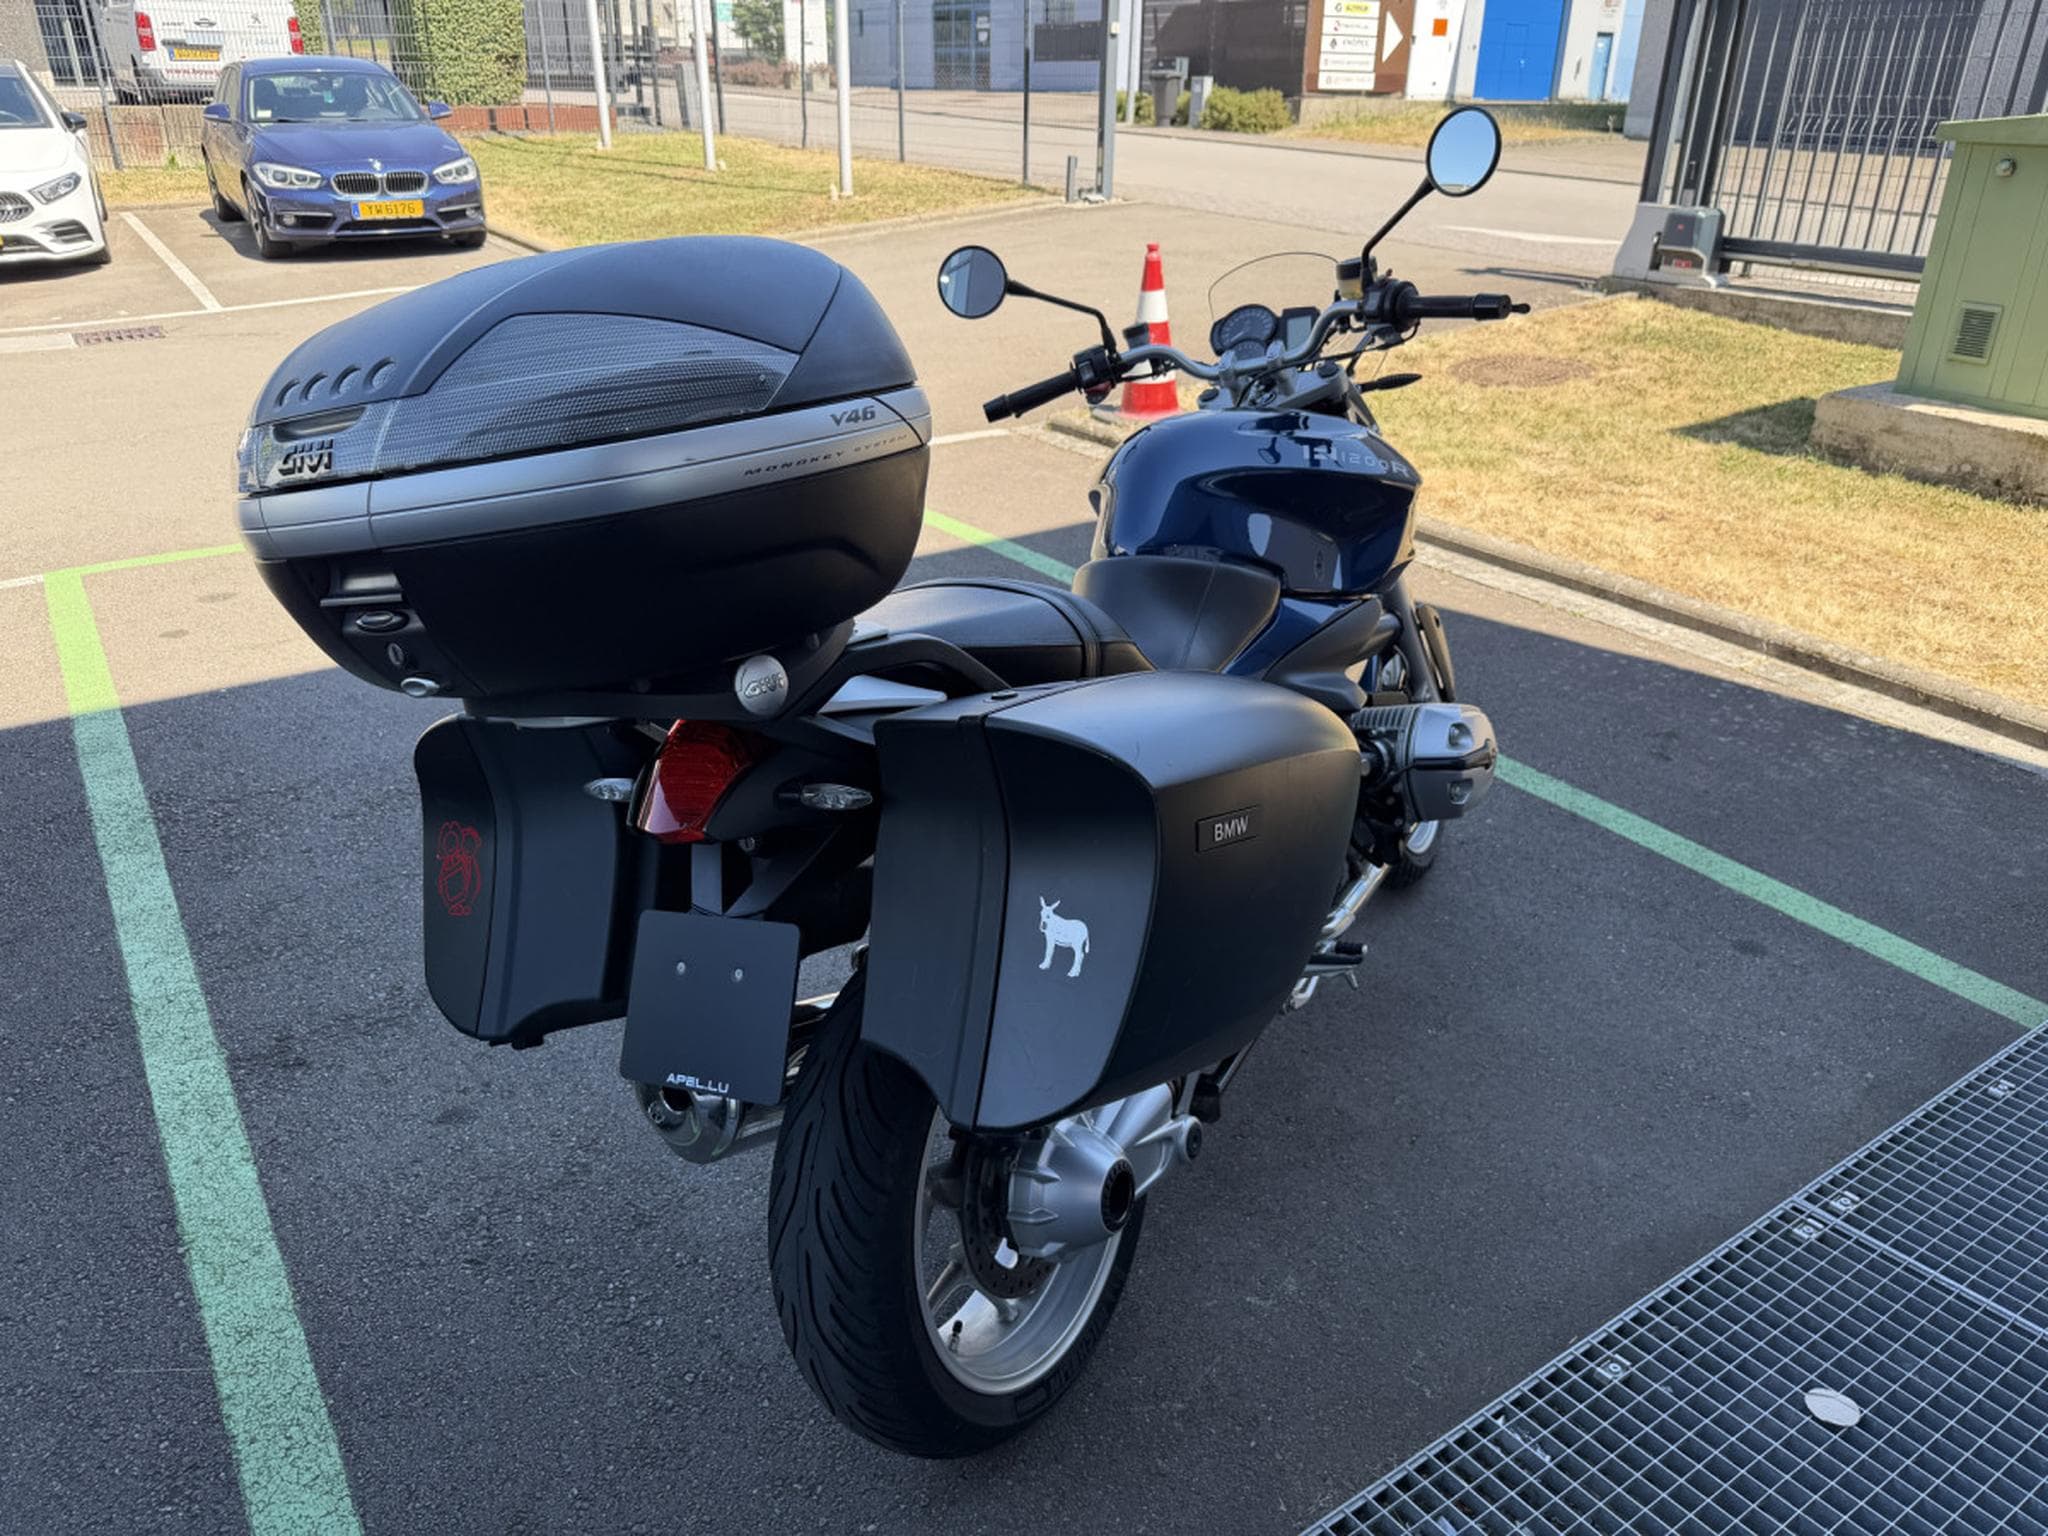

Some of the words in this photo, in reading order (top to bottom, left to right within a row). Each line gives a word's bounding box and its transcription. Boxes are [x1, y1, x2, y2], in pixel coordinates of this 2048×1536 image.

[830, 405, 876, 427] V46
[278, 438, 334, 476] GIVI
[744, 451, 844, 477] MONOKEY
[1214, 814, 1249, 842] BMW
